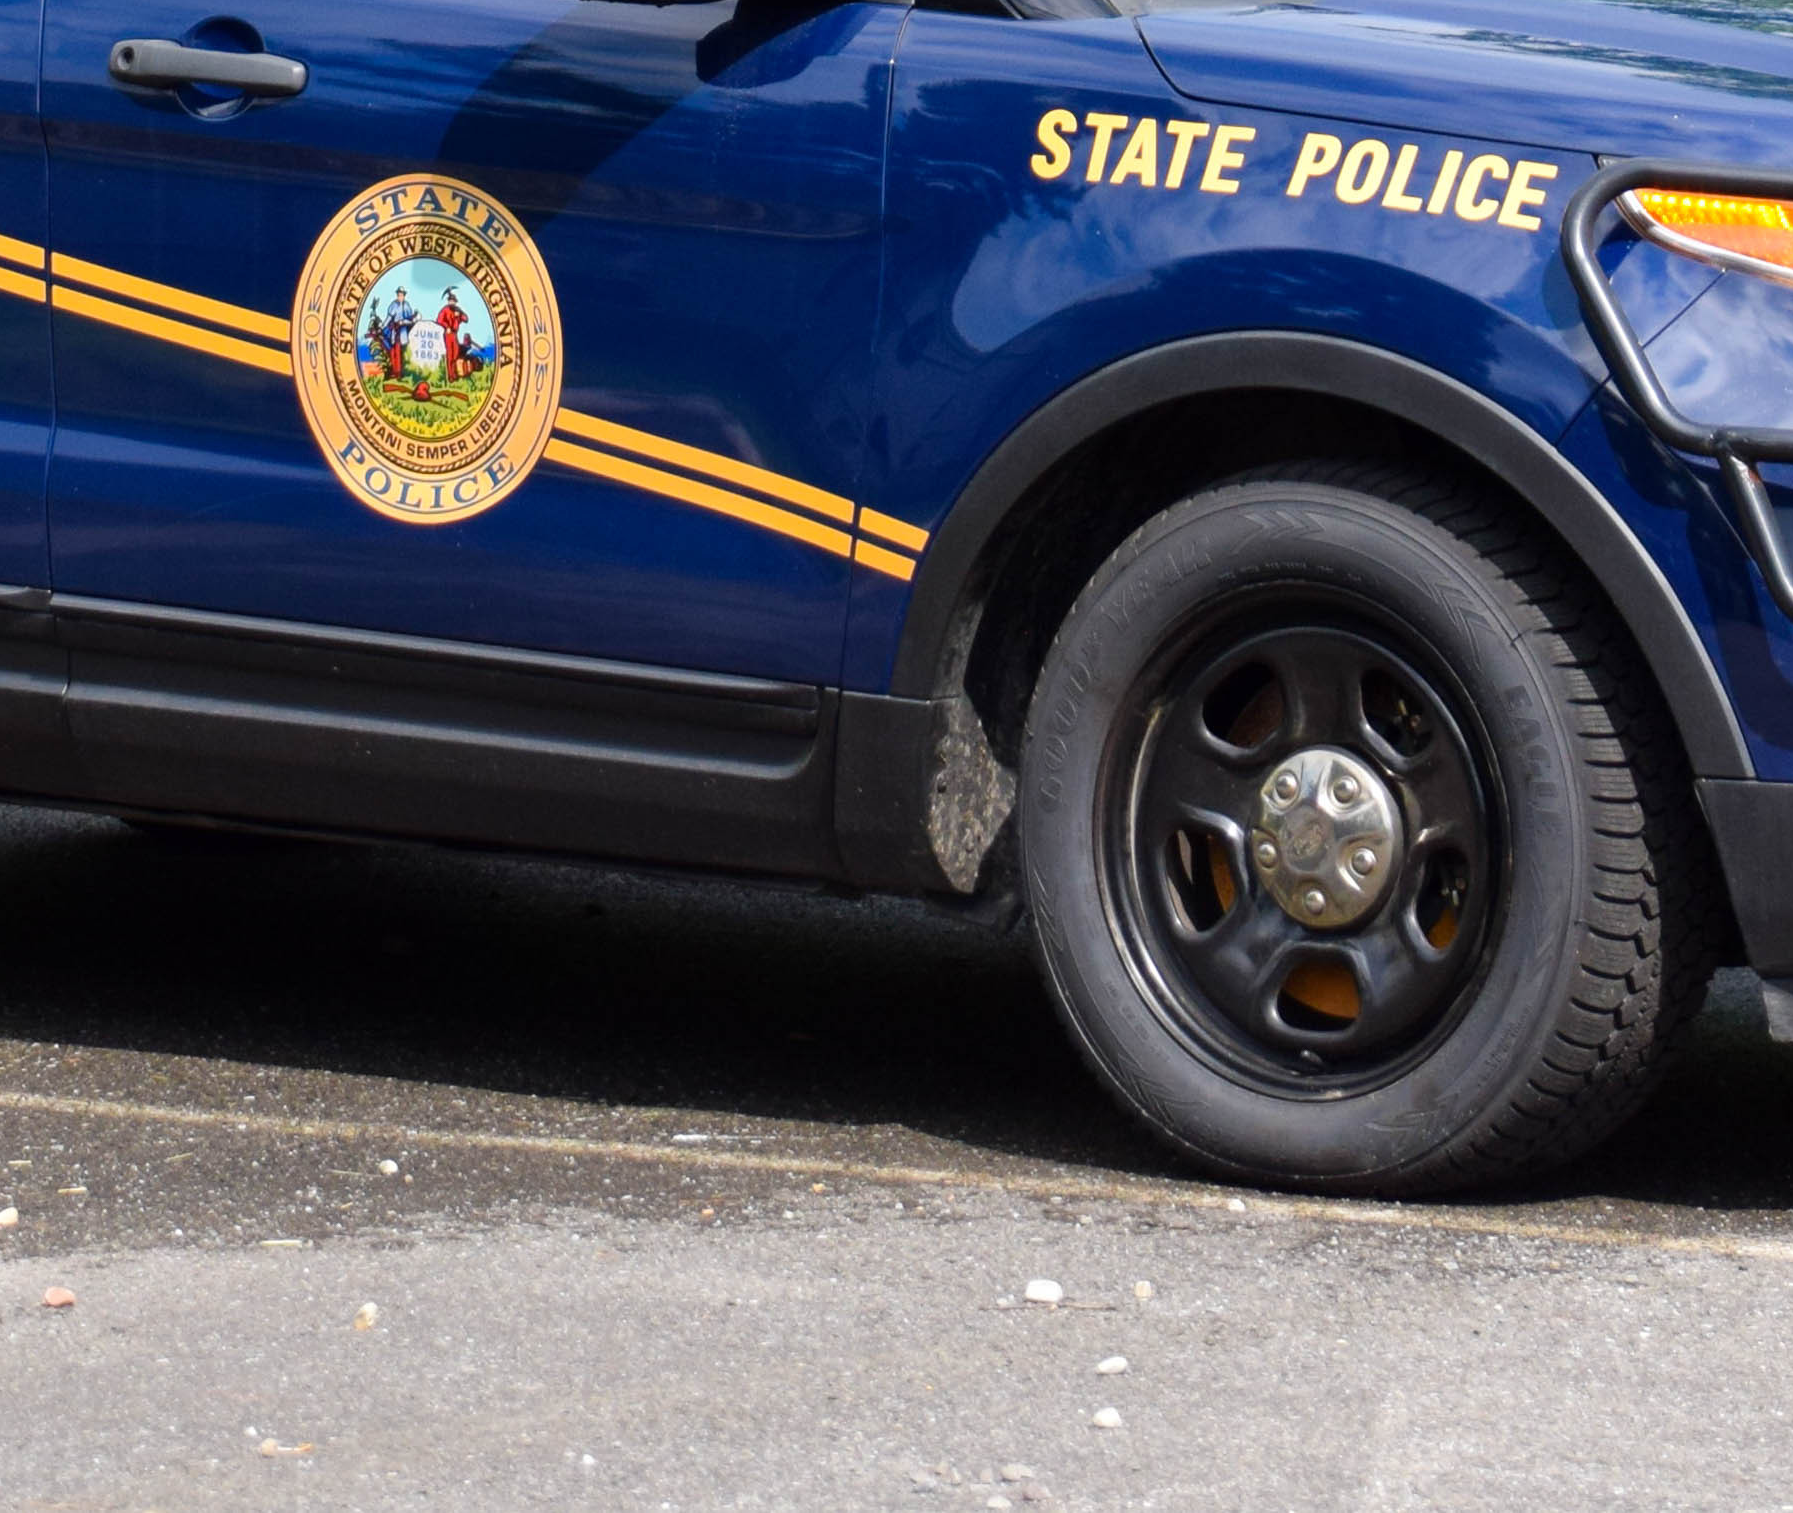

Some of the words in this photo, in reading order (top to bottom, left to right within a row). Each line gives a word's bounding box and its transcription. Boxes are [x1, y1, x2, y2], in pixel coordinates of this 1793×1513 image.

[1030, 108, 1257, 194] STATE
[1286, 132, 1559, 232] POLICE
[354, 187, 511, 249] STATE
[339, 271, 371, 355] STATE
[368, 245, 394, 273] OF
[399, 235, 461, 259] WEST
[462, 255, 514, 369] VIRGINIA
[414, 328, 441, 340] JUNE
[420, 339, 435, 350] 20
[347, 378, 402, 451] MONTANI
[406, 440, 469, 460] SEMPER
[471, 395, 506, 446] LIBERI
[338, 436, 516, 510] POLICE
